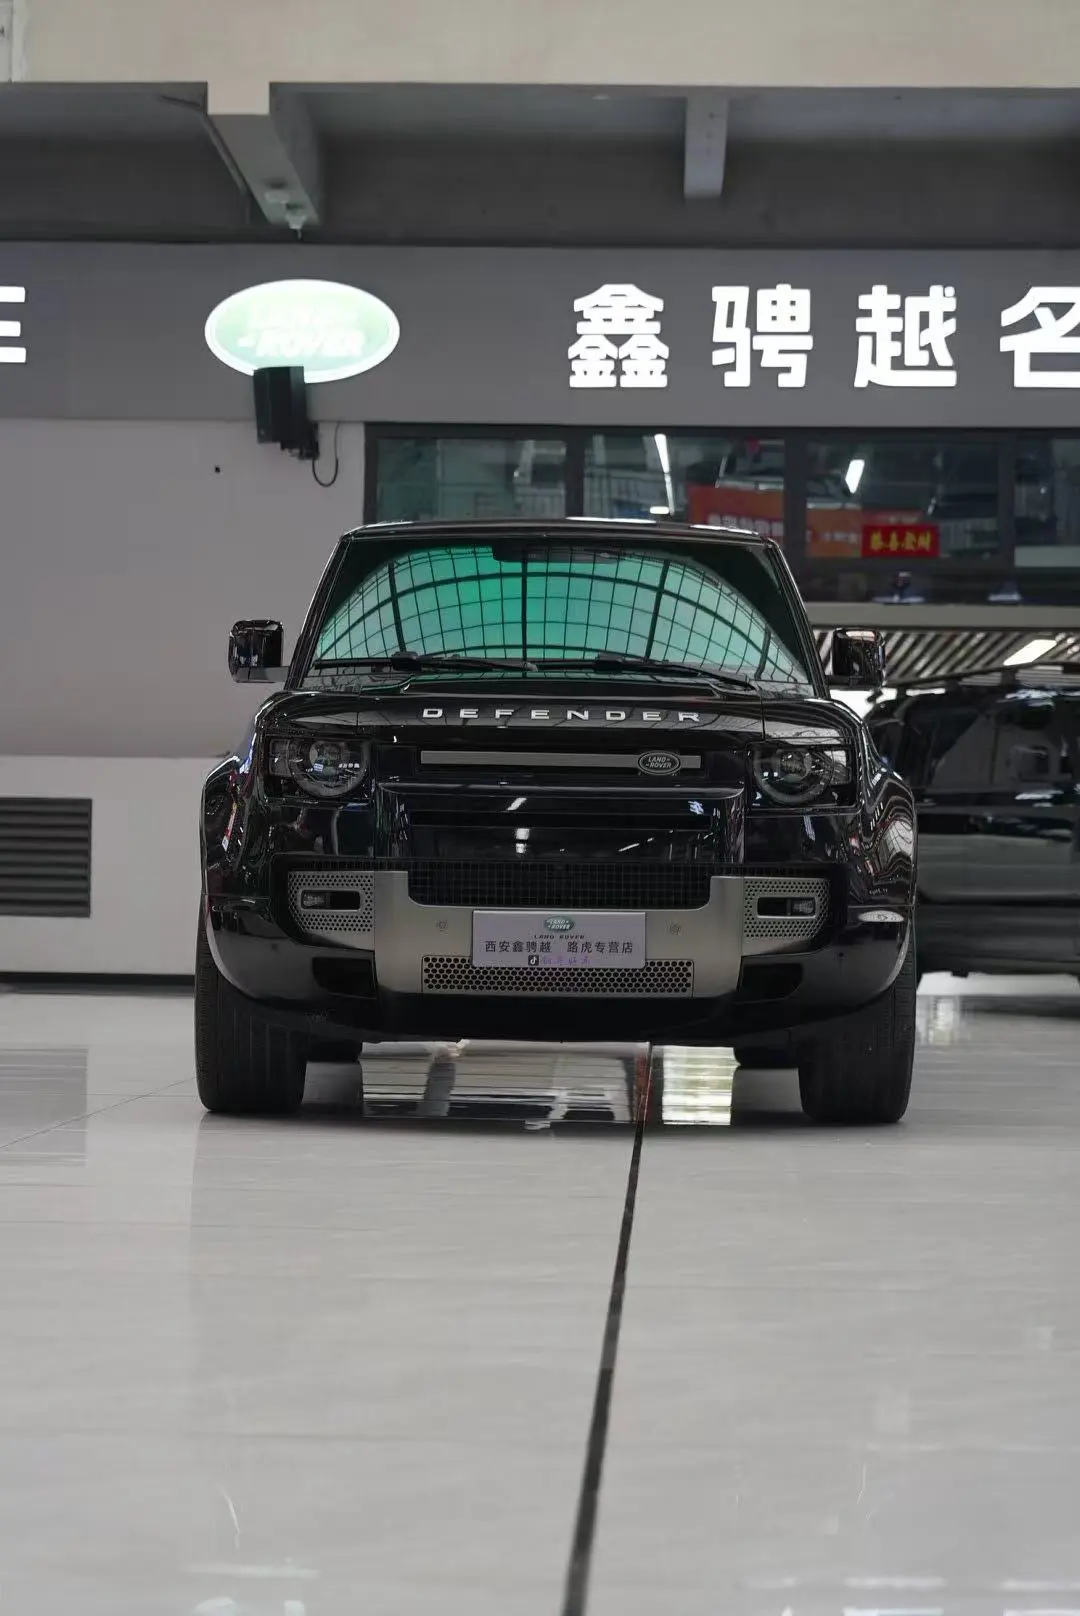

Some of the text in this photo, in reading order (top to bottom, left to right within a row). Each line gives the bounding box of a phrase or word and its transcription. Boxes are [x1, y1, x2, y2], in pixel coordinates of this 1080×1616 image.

[568, 283, 1080, 389] 鑫骋越名
[422, 708, 702, 722] DEFENDER
[567, 940, 634, 954] 路虎专营店
